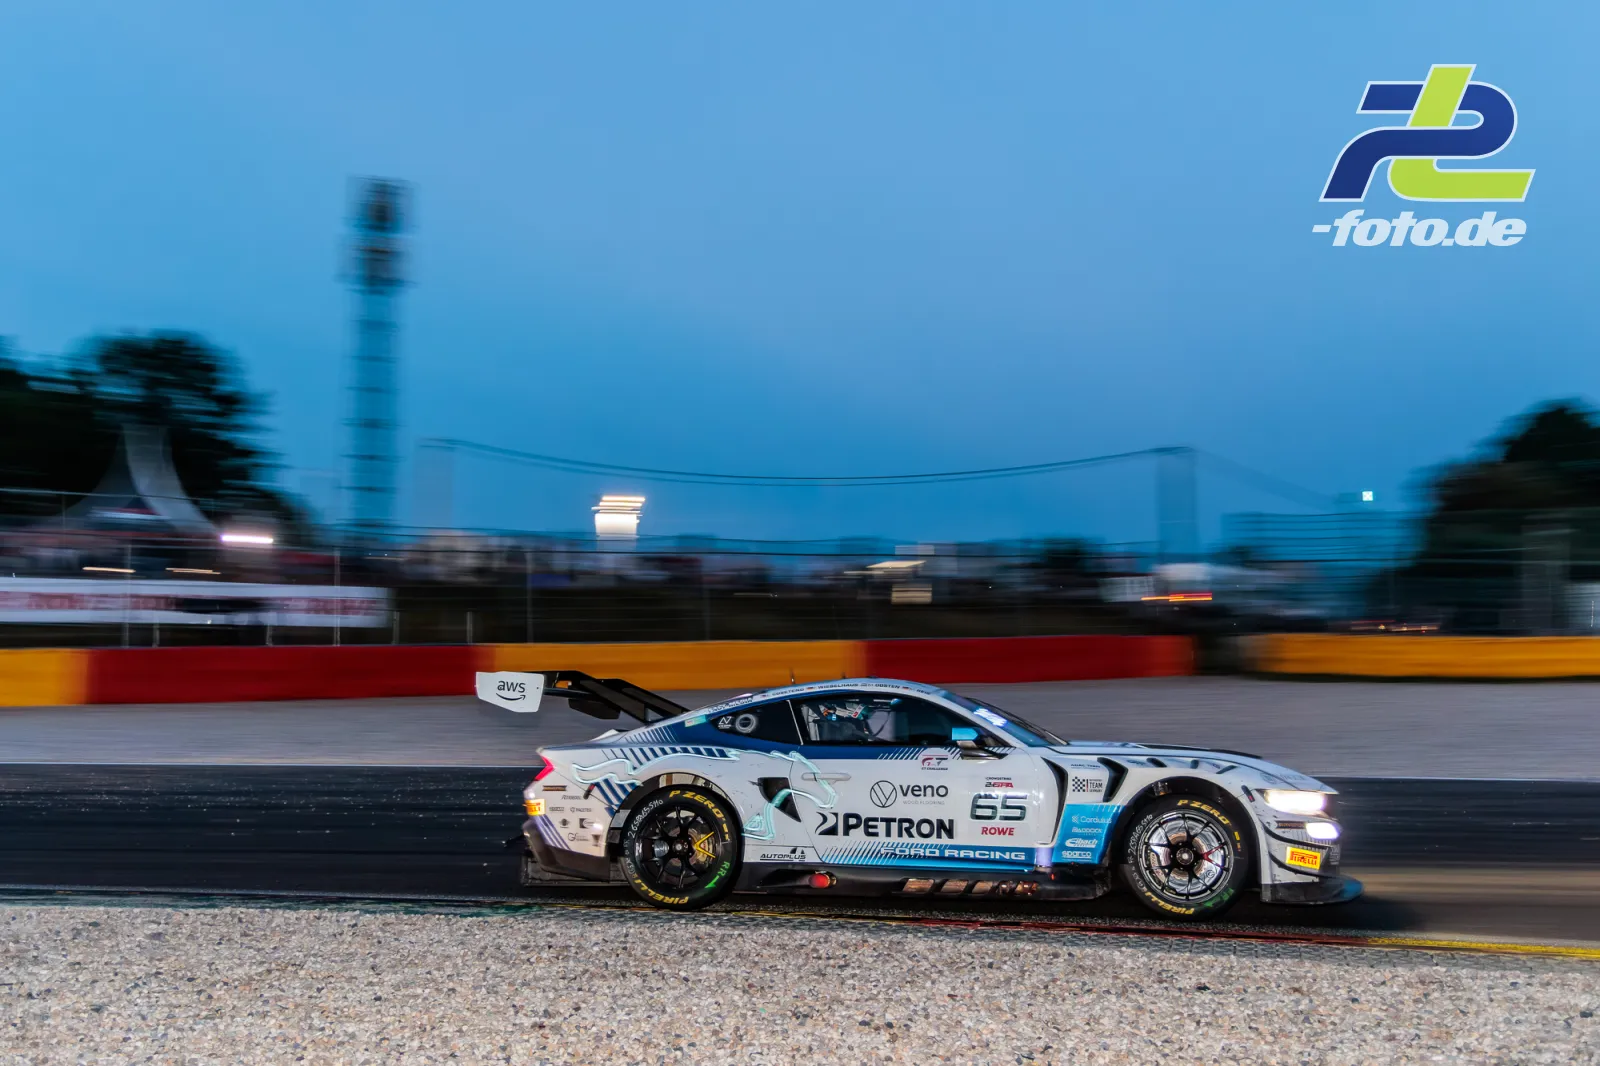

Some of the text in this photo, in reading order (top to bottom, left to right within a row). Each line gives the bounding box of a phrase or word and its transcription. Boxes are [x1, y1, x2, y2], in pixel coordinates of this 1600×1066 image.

[497, 680, 526, 693] aws
[899, 784, 949, 797] veno
[970, 793, 1028, 821] 65
[843, 813, 954, 839] PETRON
[981, 827, 1015, 836] ROWE
[880, 847, 1026, 860] FORD RACING
[1290, 851, 1318, 866] PIRELLI
[634, 879, 689, 904] PIRELLI
[1145, 891, 1195, 915] PIRELLI
